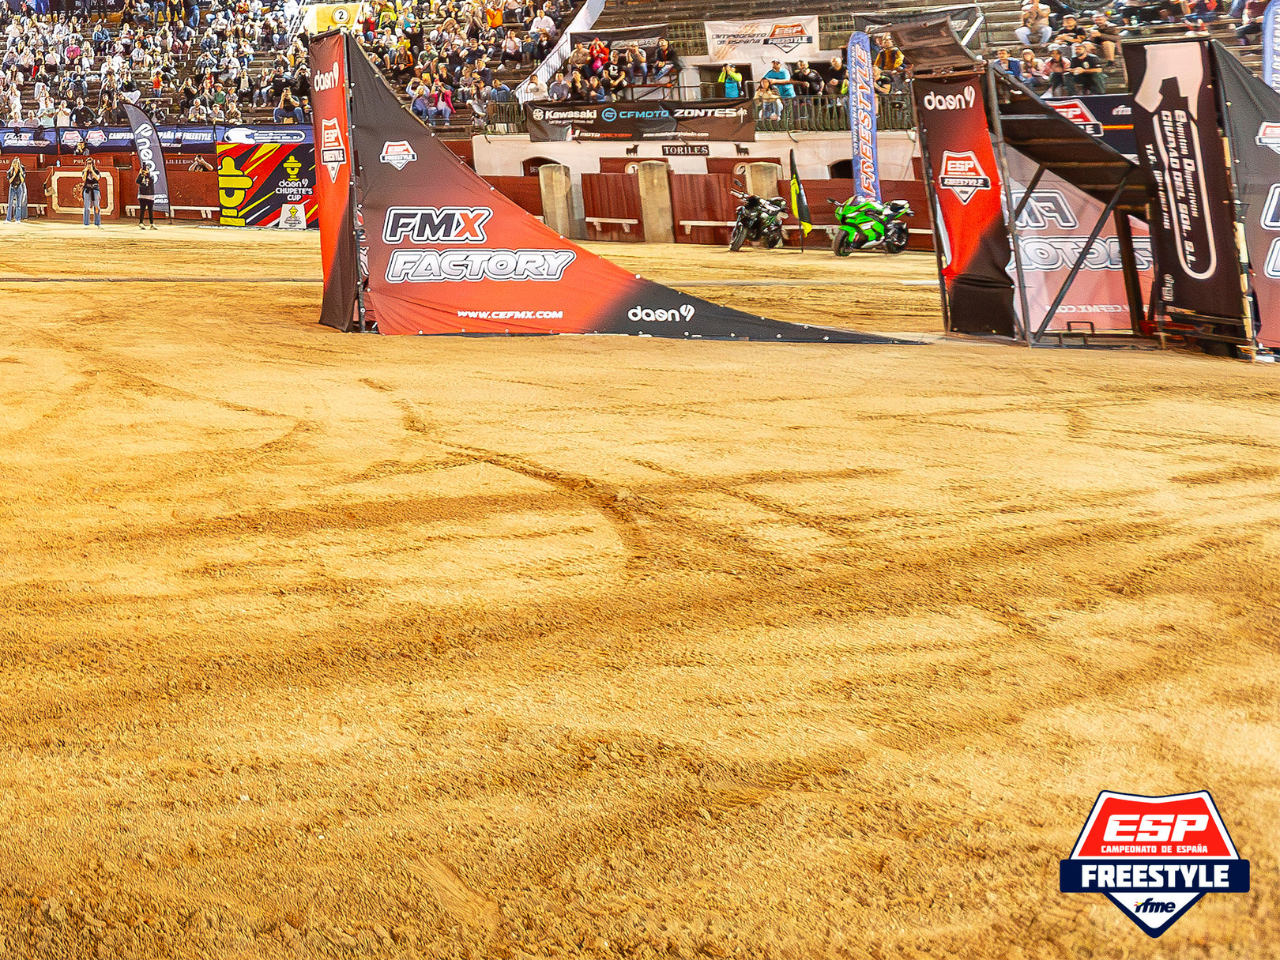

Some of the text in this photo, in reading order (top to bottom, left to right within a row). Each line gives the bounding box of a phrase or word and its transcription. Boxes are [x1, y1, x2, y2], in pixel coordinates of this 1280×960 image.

[338, 10, 346, 20] 2
[545, 108, 597, 120] Kawasaki
[619, 109, 670, 119] CFMOTO
[673, 108, 738, 118] ZONTES
[855, 43, 877, 198] FREESTYLE
[663, 146, 709, 155] TORILES
[947, 160, 975, 172] ESP
[275, 187, 314, 195] CHUPETE'S
[383, 206, 493, 244] FMX
[385, 248, 577, 284] FACTORY
